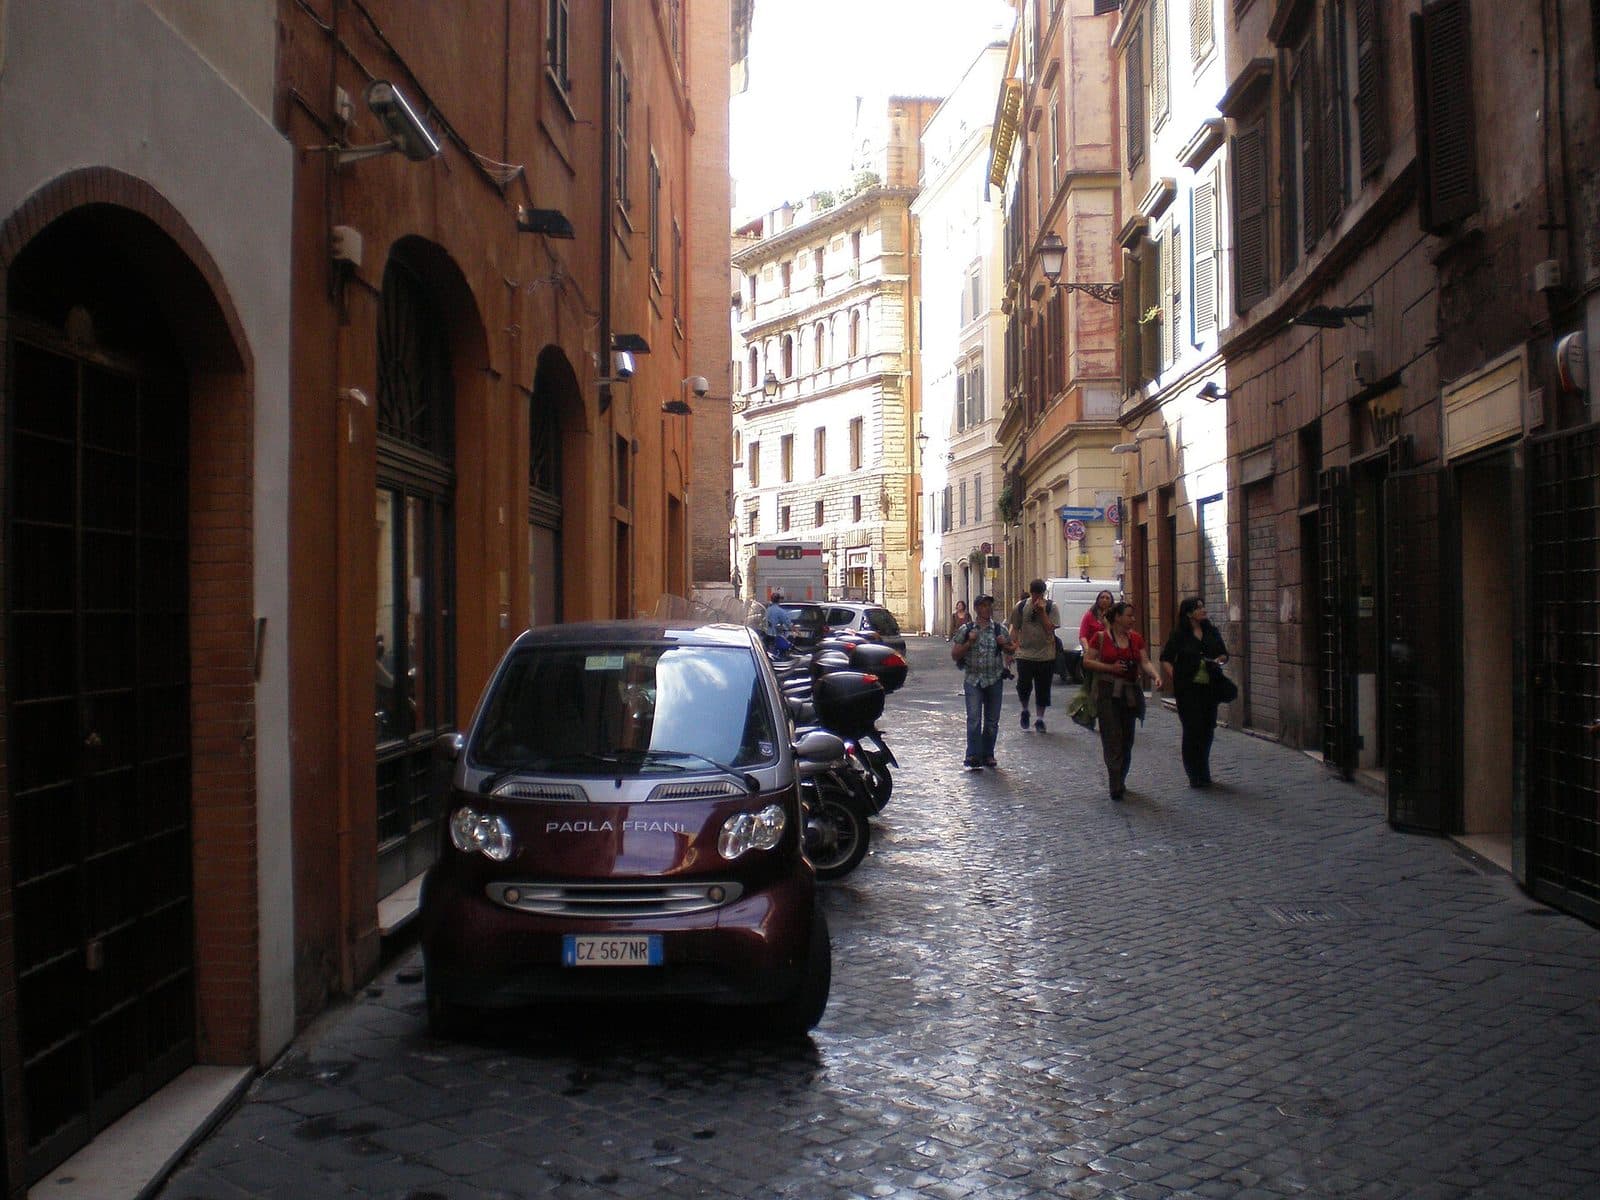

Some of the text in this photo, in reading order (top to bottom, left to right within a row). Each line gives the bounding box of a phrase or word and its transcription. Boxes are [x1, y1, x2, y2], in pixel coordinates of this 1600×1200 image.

[546, 821, 685, 833] PAOLA FRANI
[576, 941, 648, 960] CZ 567NR
